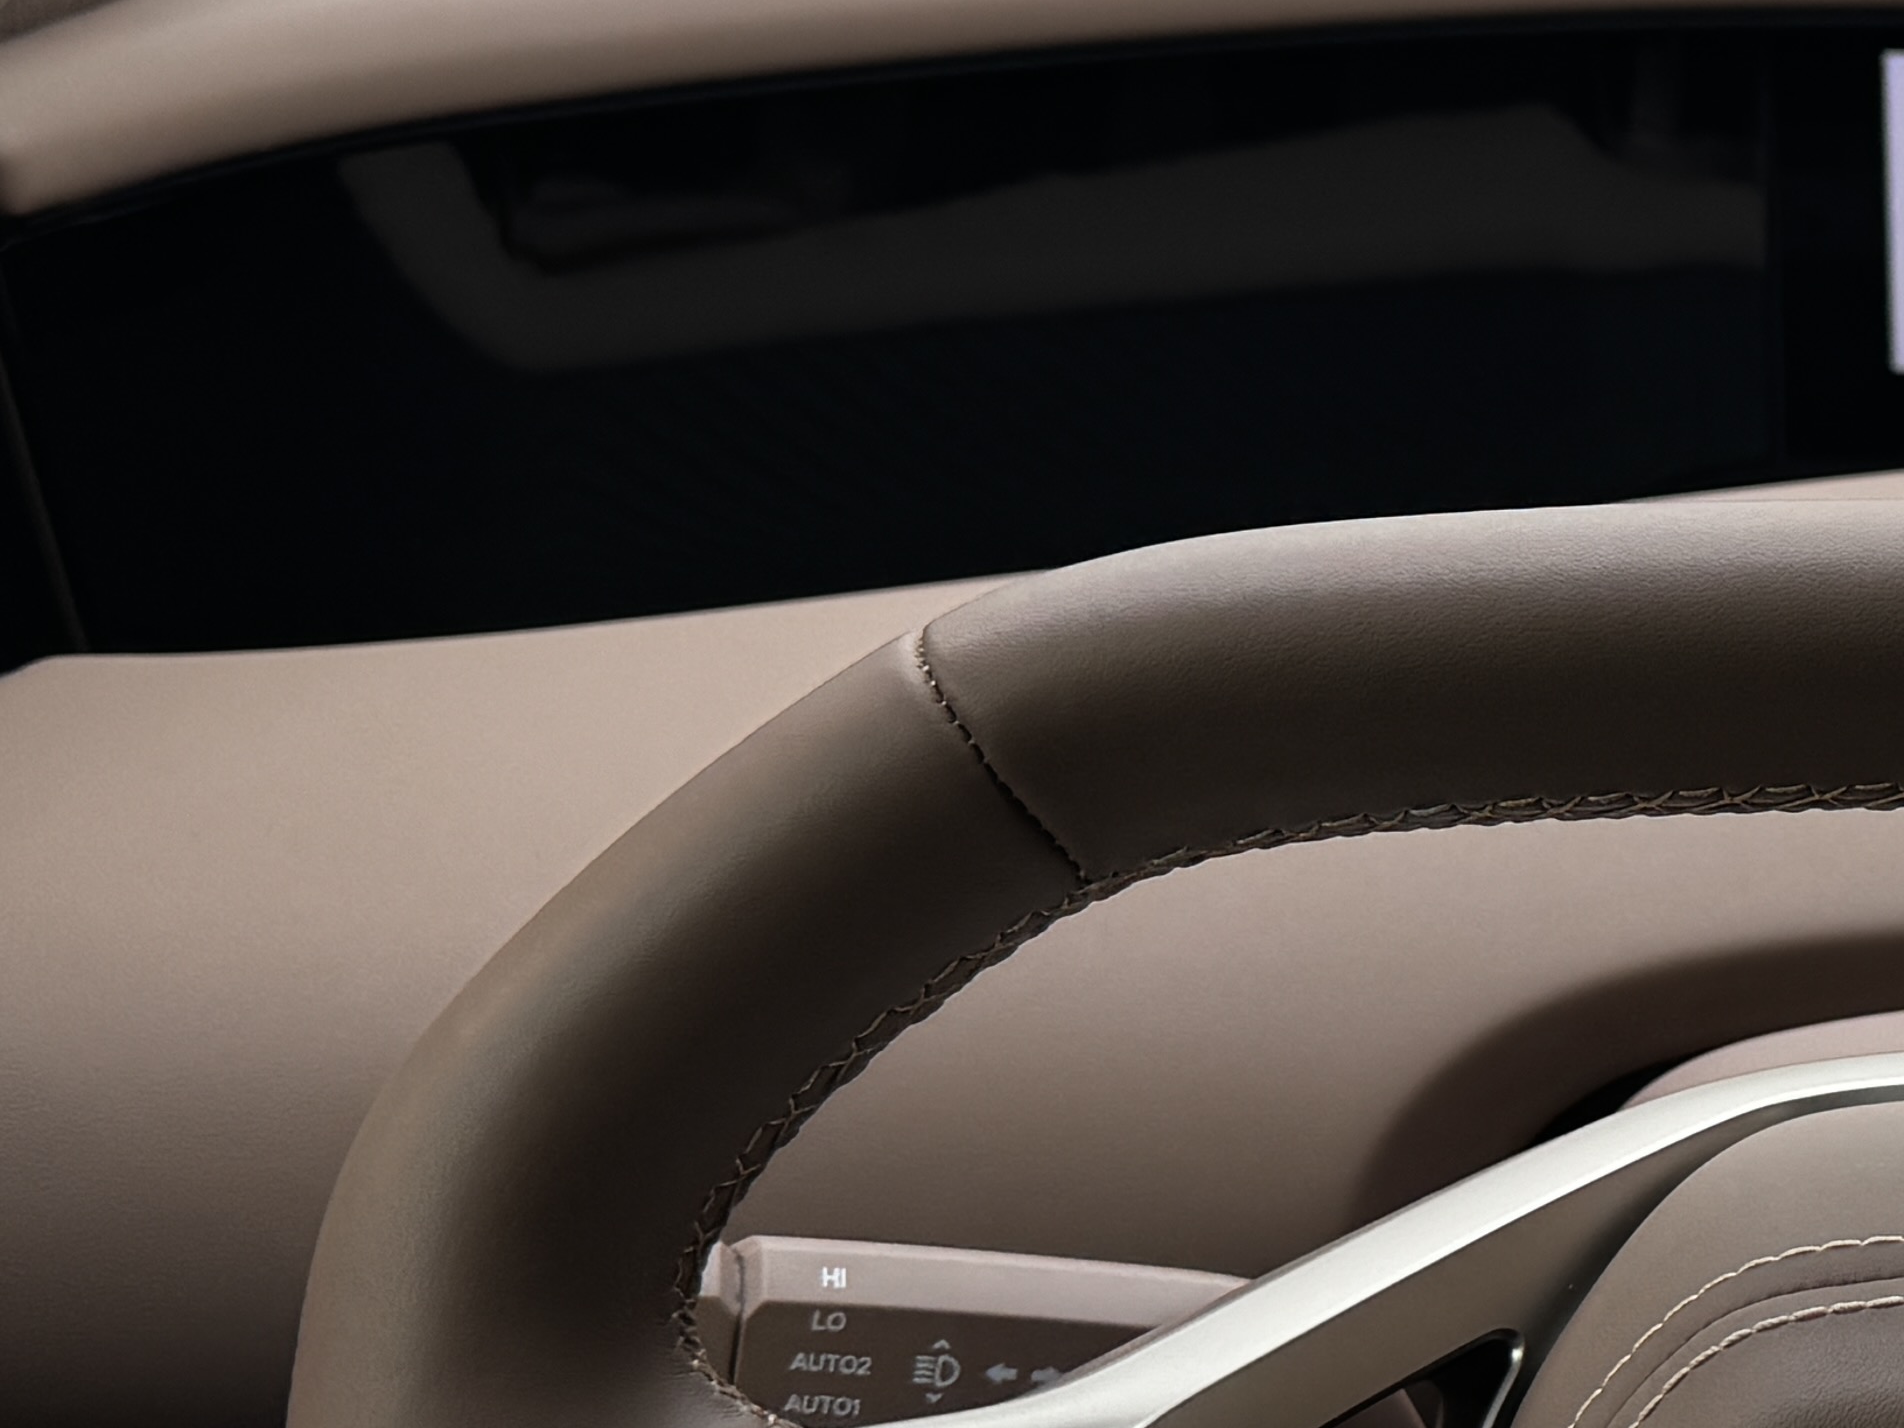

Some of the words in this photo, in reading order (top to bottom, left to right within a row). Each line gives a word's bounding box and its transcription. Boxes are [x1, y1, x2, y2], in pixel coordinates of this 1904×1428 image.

[821, 1267, 848, 1289] HI
[811, 1310, 847, 1333] LO
[789, 1351, 872, 1376] AUTO2
[783, 1393, 862, 1417] AUTO1
